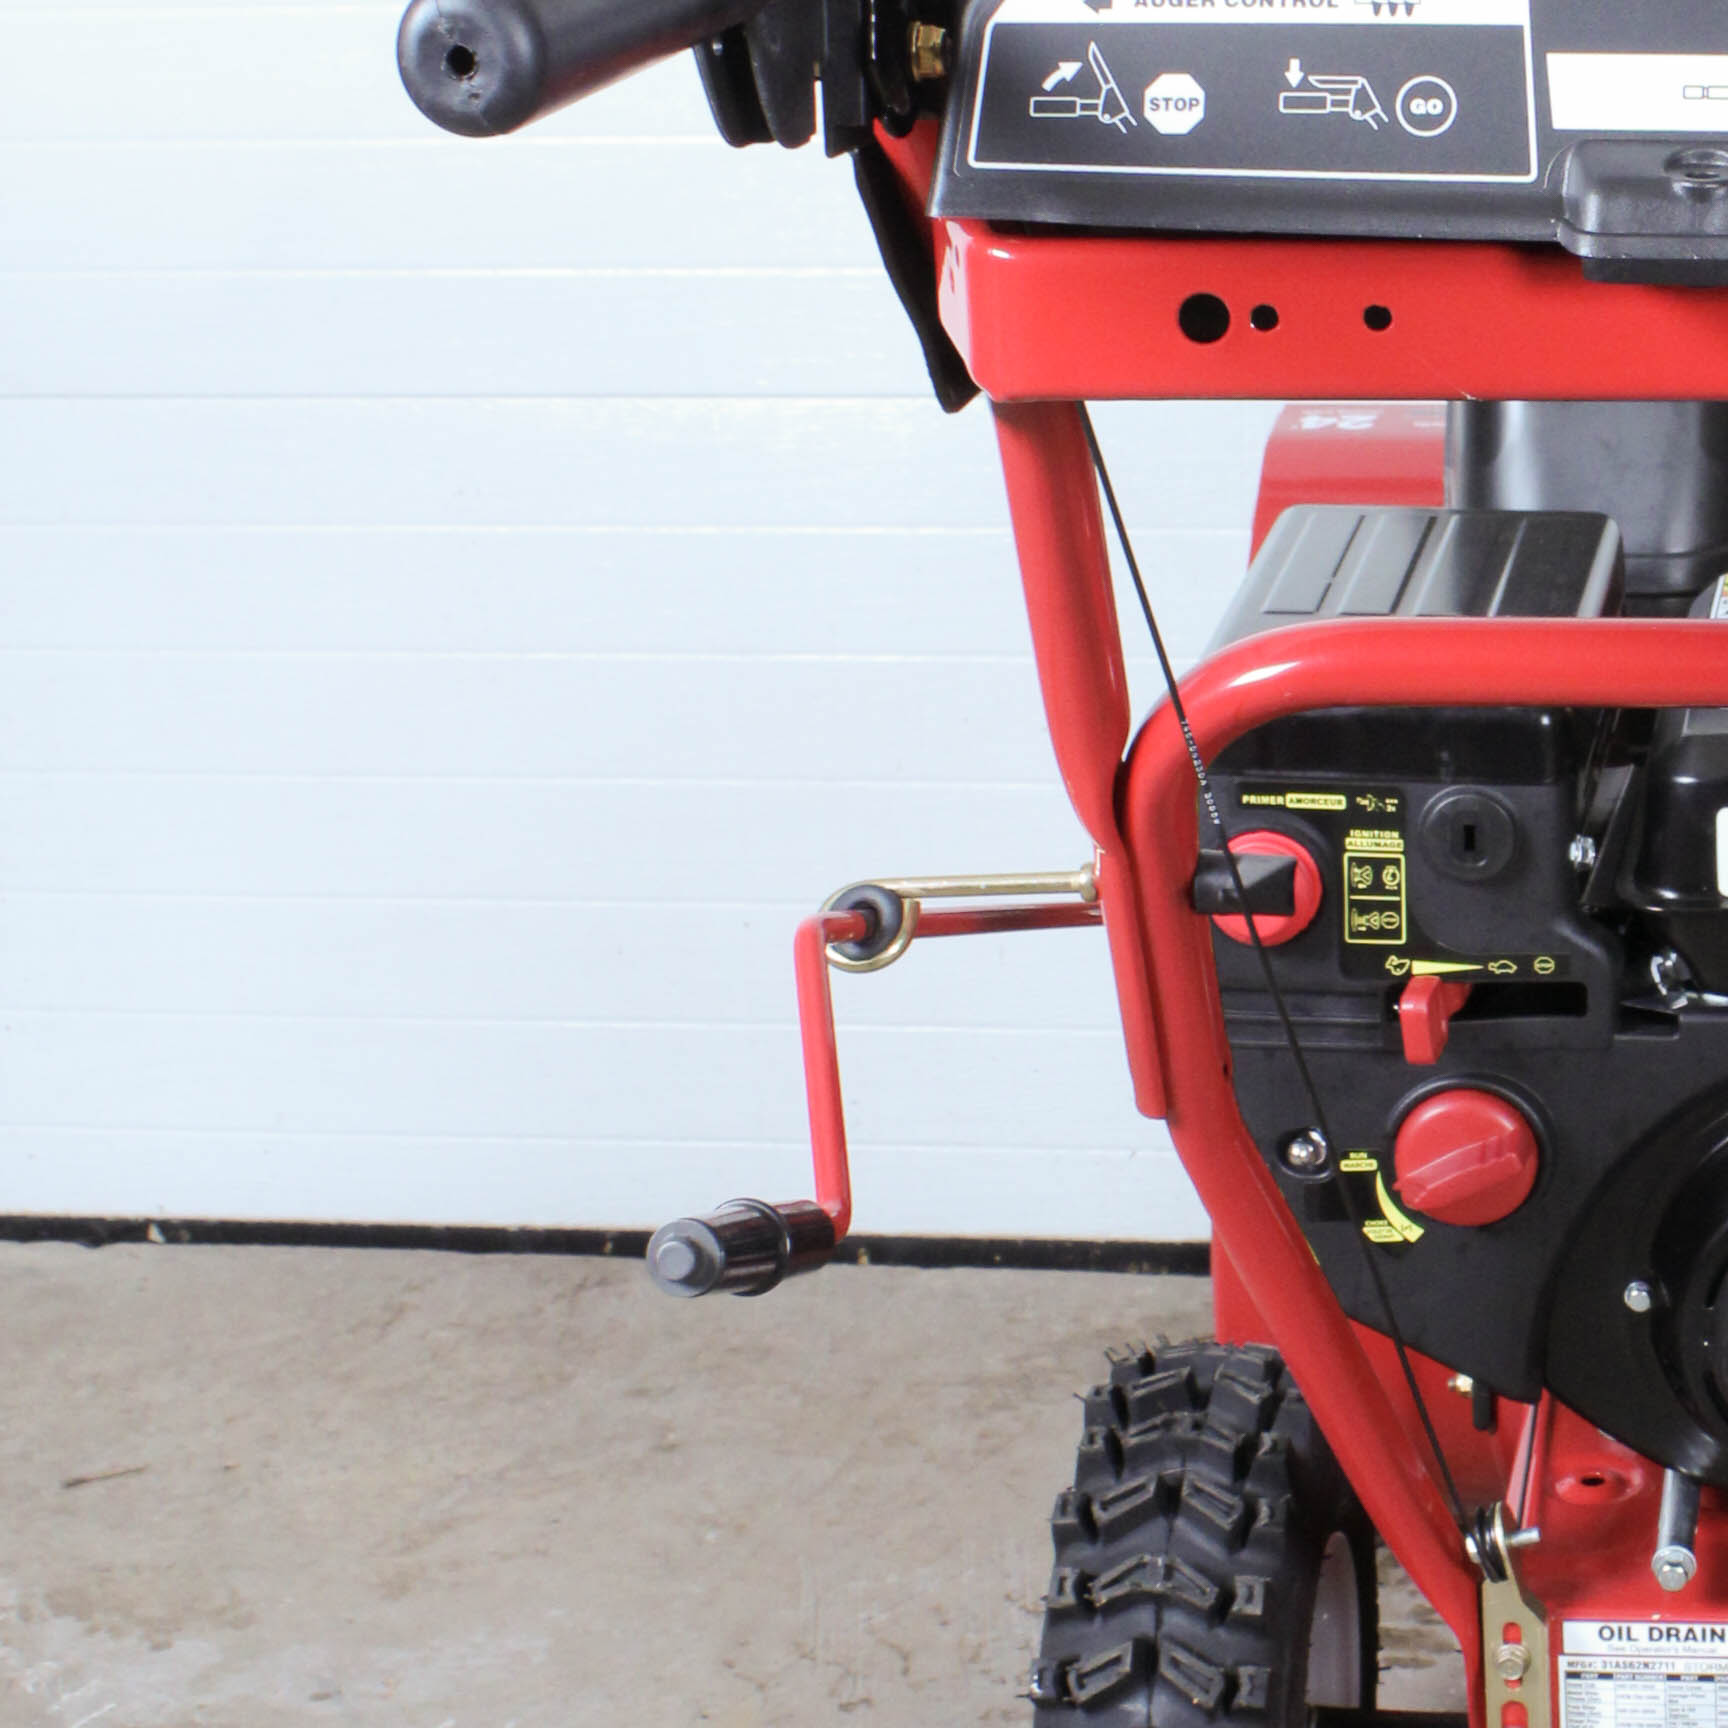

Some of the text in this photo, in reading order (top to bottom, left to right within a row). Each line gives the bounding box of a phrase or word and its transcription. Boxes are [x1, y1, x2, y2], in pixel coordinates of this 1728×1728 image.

[1149, 95, 1200, 114] STOP
[1408, 98, 1442, 115] GO
[1241, 794, 1284, 805] PRIMER
[1288, 797, 1343, 806] AMORCEUR
[1349, 829, 1400, 839] IGNITION
[1346, 840, 1403, 849] ALLUMAGE
[1598, 1625, 1726, 1643] OIL DRAIN
